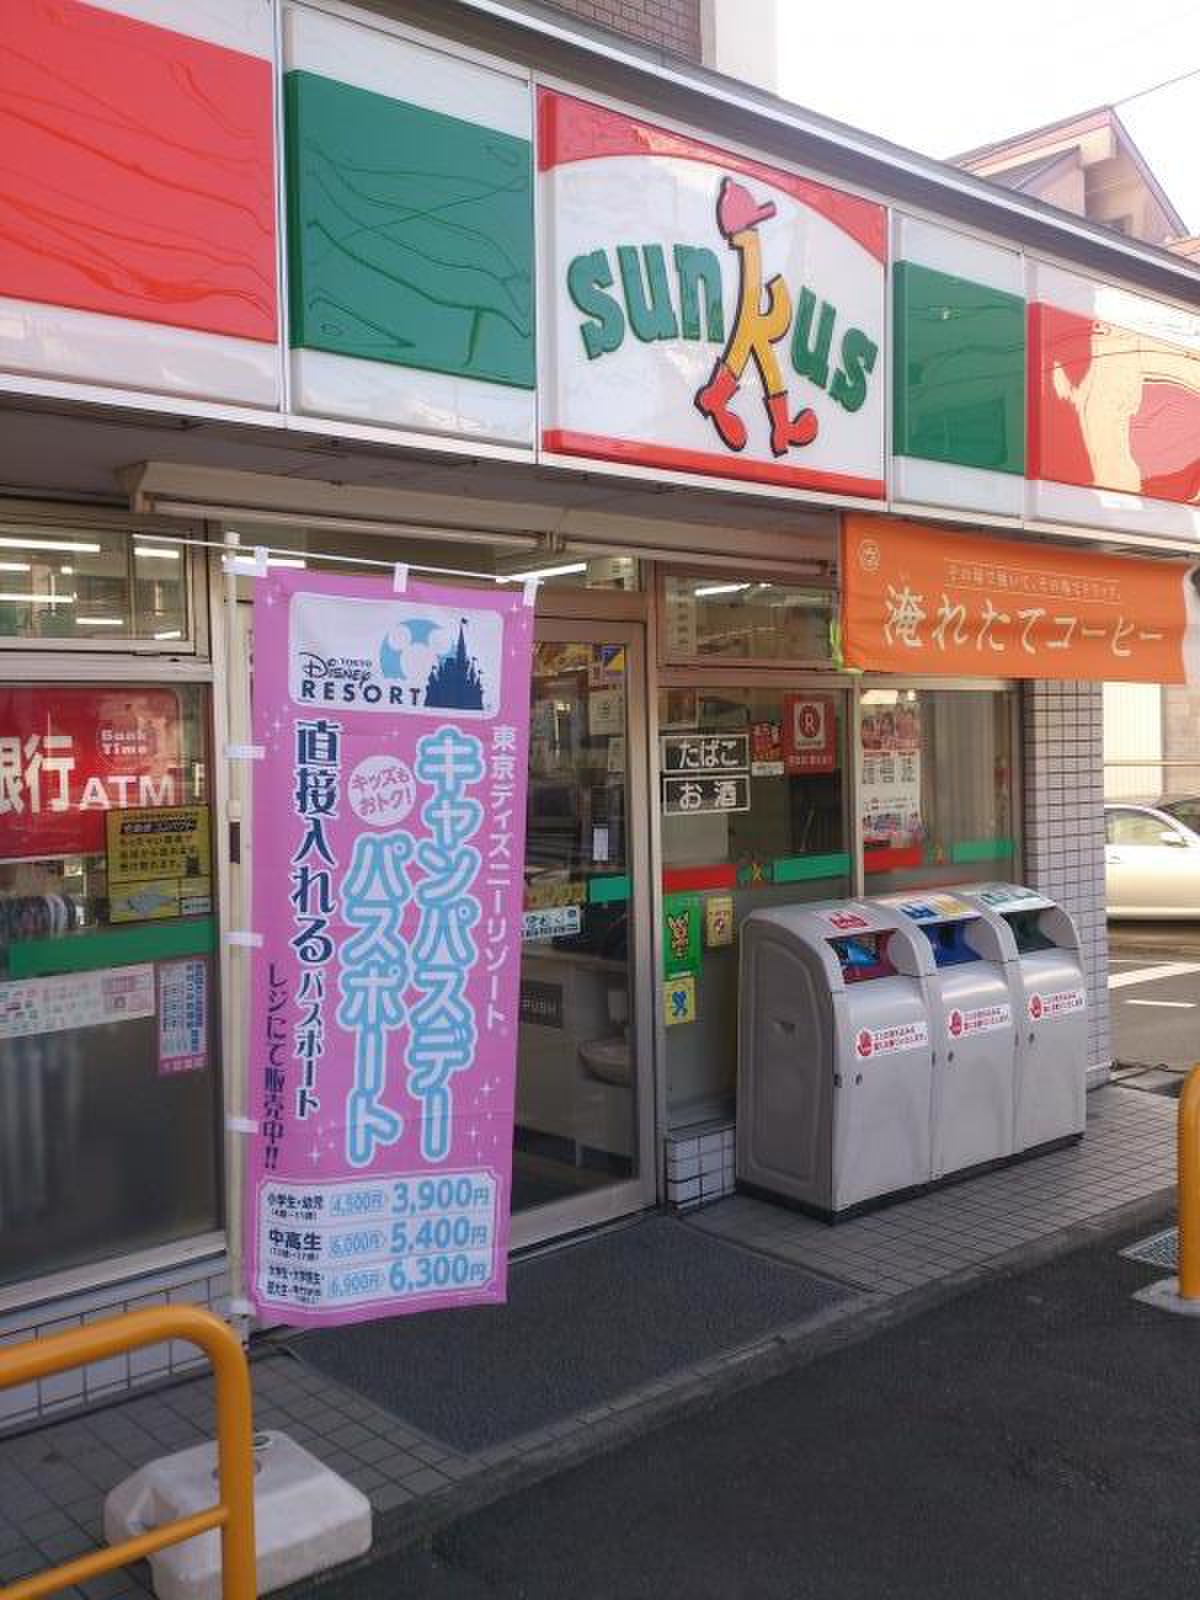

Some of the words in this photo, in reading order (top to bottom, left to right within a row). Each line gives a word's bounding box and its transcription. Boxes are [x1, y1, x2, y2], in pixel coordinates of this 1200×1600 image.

[301, 680, 421, 706] RESORT
[679, 738, 740, 768] たばこ
[80, 774, 178, 811] ATM
[486, 726, 518, 1031] 東京ディズニーリゾート
[407, 725, 485, 1162] キャンパスデー
[336, 831, 416, 1166] パスポート
[391, 1177, 489, 1215] 3,900円
[269, 1229, 322, 1252] 中高生
[391, 1216, 487, 1254] 5,400円
[389, 1253, 486, 1292] 6,300円
